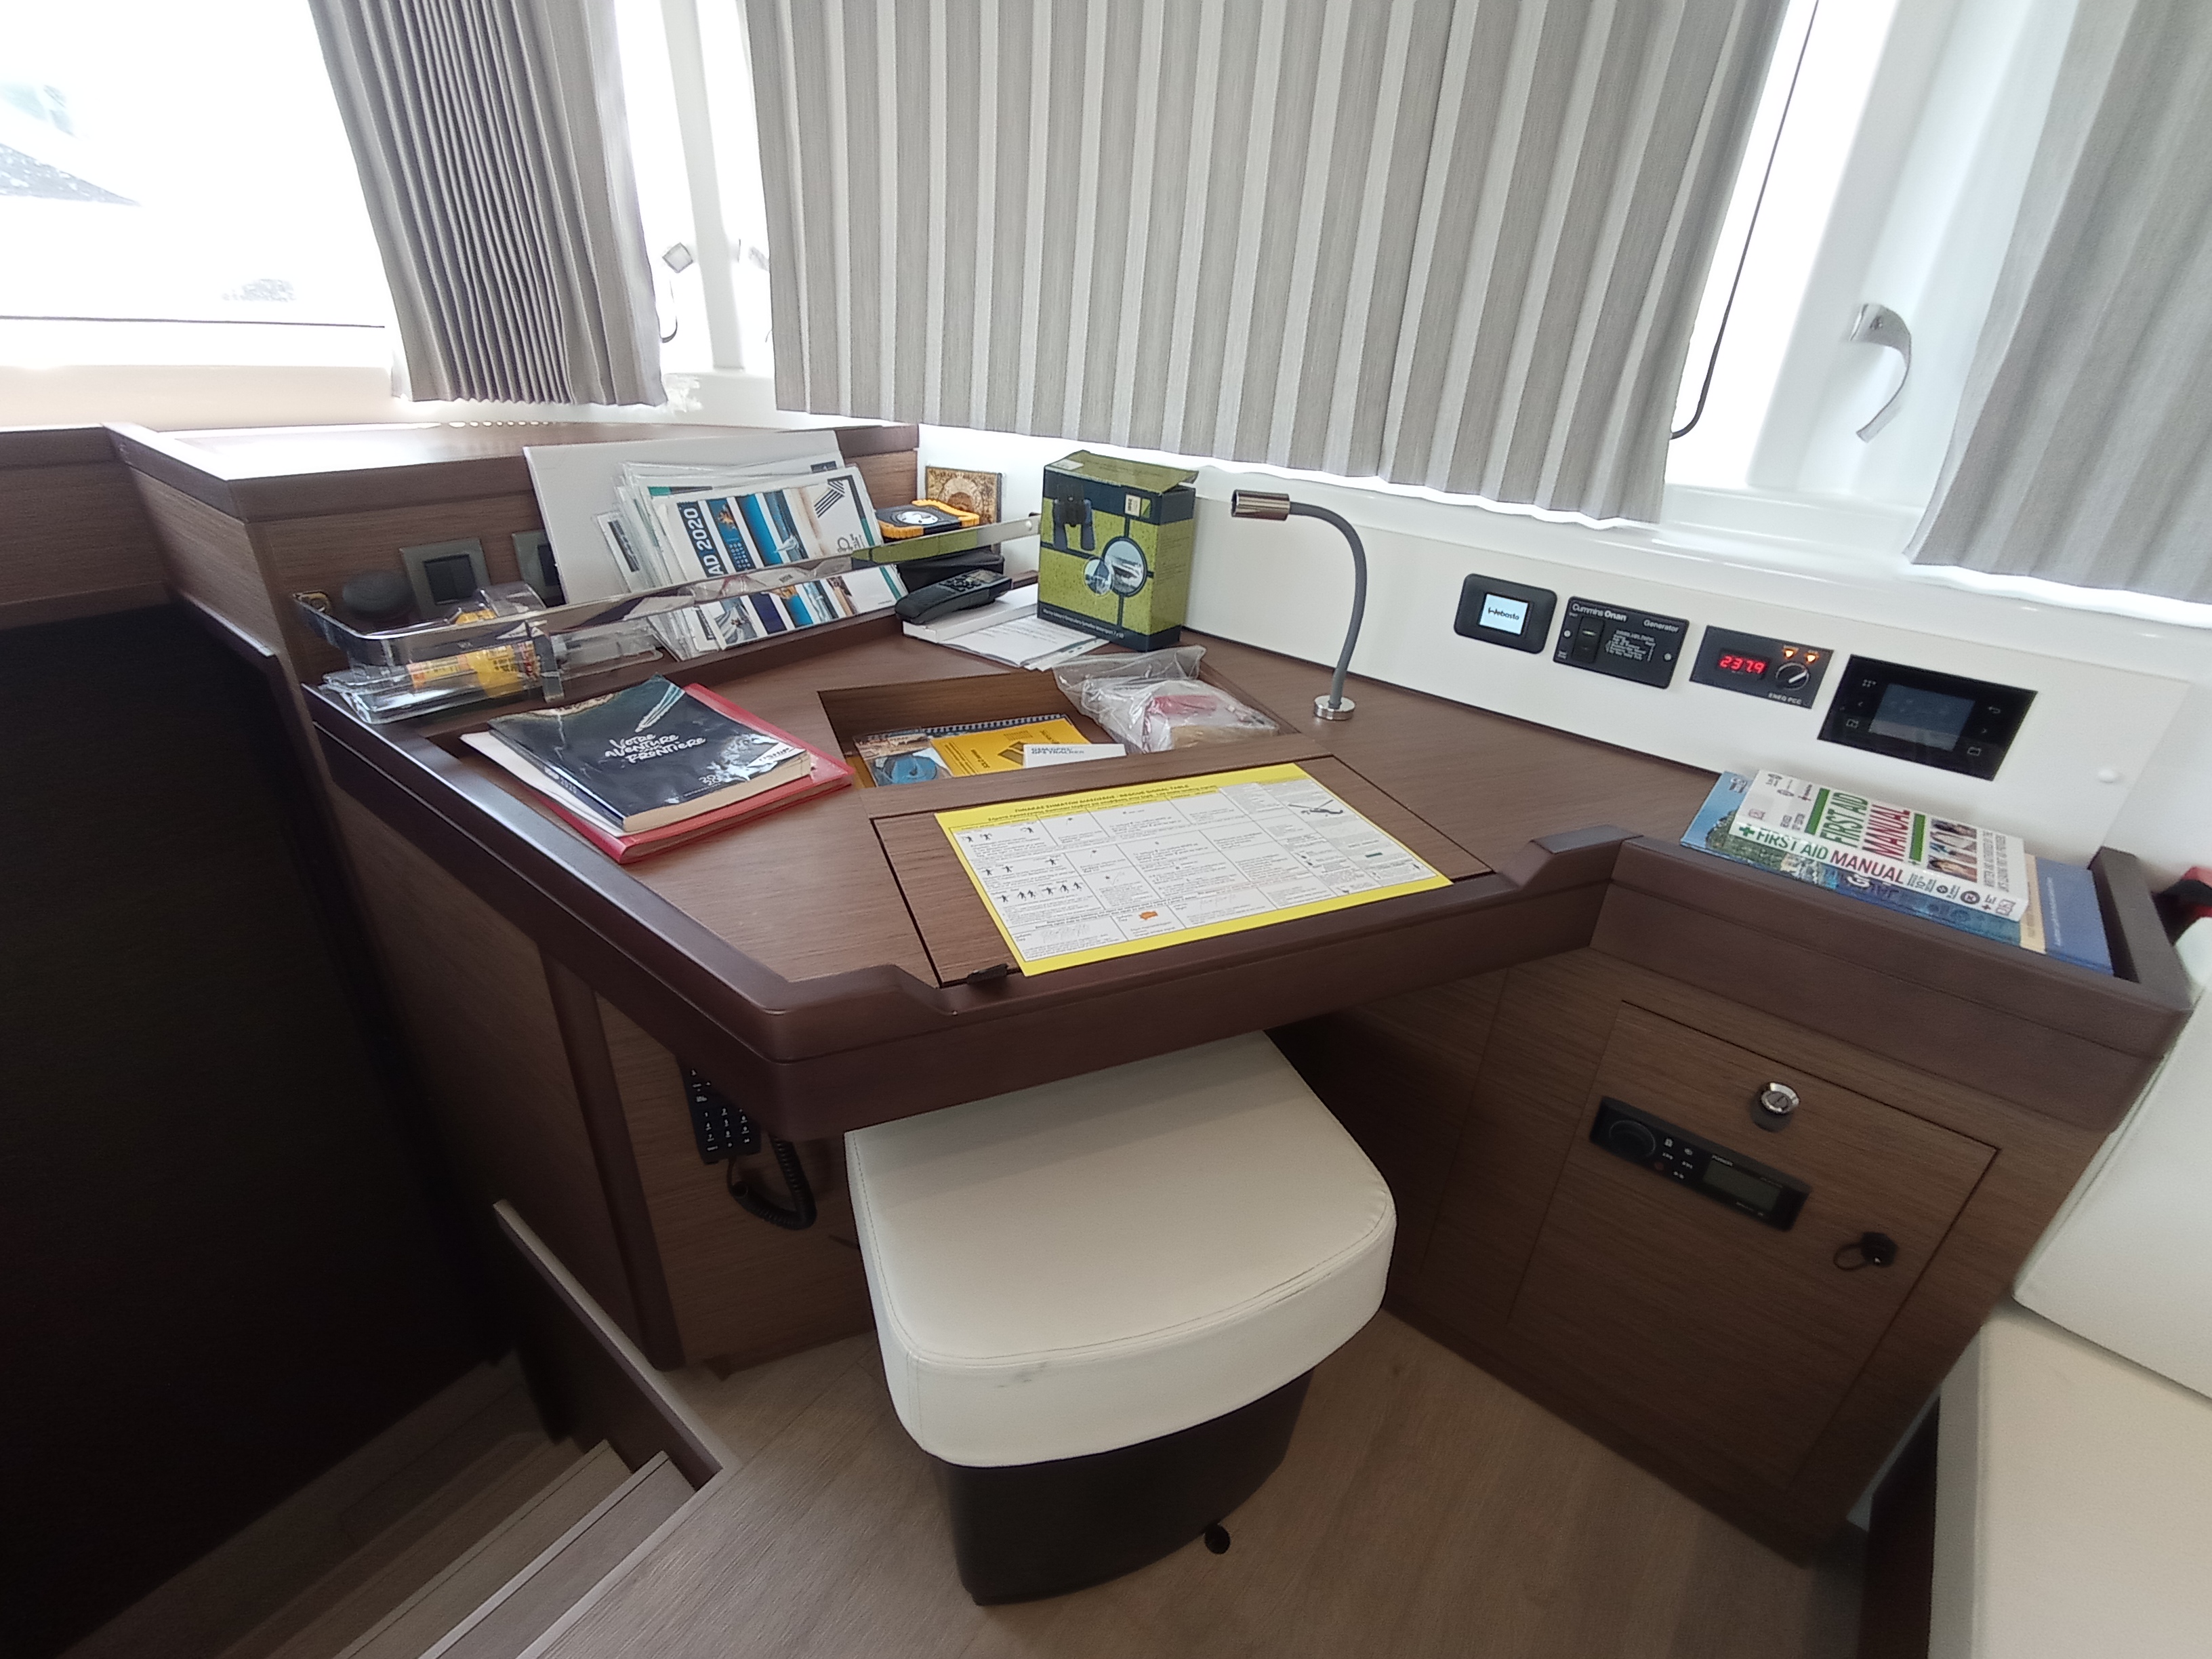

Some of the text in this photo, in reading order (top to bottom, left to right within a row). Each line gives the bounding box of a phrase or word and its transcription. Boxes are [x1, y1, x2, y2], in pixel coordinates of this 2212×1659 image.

[684, 508, 712, 550] 2020
[1488, 607, 1520, 620] Webasto
[1572, 603, 1603, 617] Cummins
[1604, 611, 1626, 621] Onan
[1643, 619, 1679, 632] Generator
[1820, 792, 1868, 848] FIRST AID
[1862, 804, 1910, 861] MANUAL
[1756, 830, 1797, 851] FIRST
[1801, 844, 1828, 860] AID
[1830, 850, 1903, 884] MANUAL
